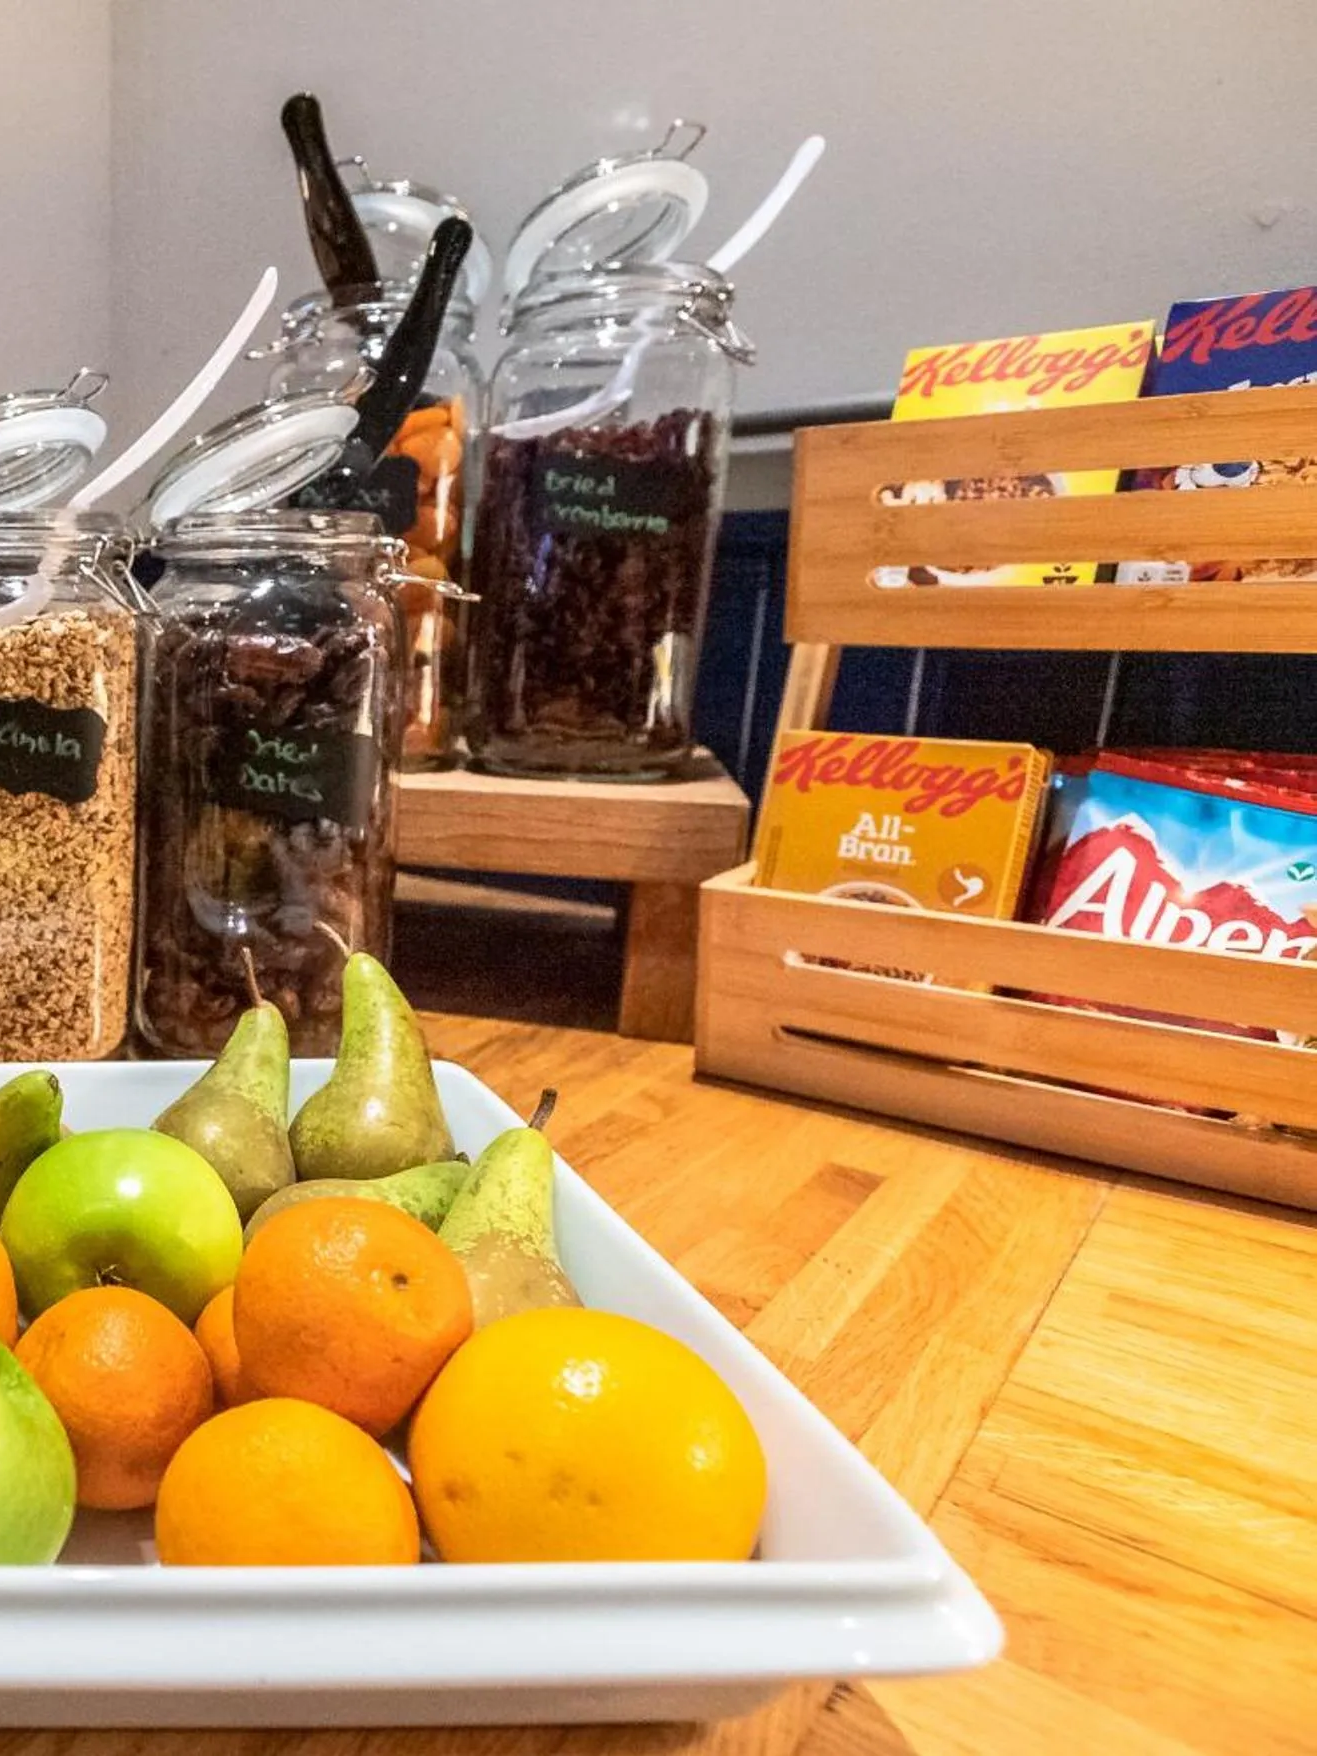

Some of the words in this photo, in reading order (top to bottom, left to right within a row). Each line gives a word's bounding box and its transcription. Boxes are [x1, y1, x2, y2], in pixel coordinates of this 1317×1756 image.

[898, 329, 1153, 398] Kellogg's
[774, 737, 1027, 818] Kellogg's
[838, 833, 913, 866] Bran
[851, 812, 916, 841] All-
